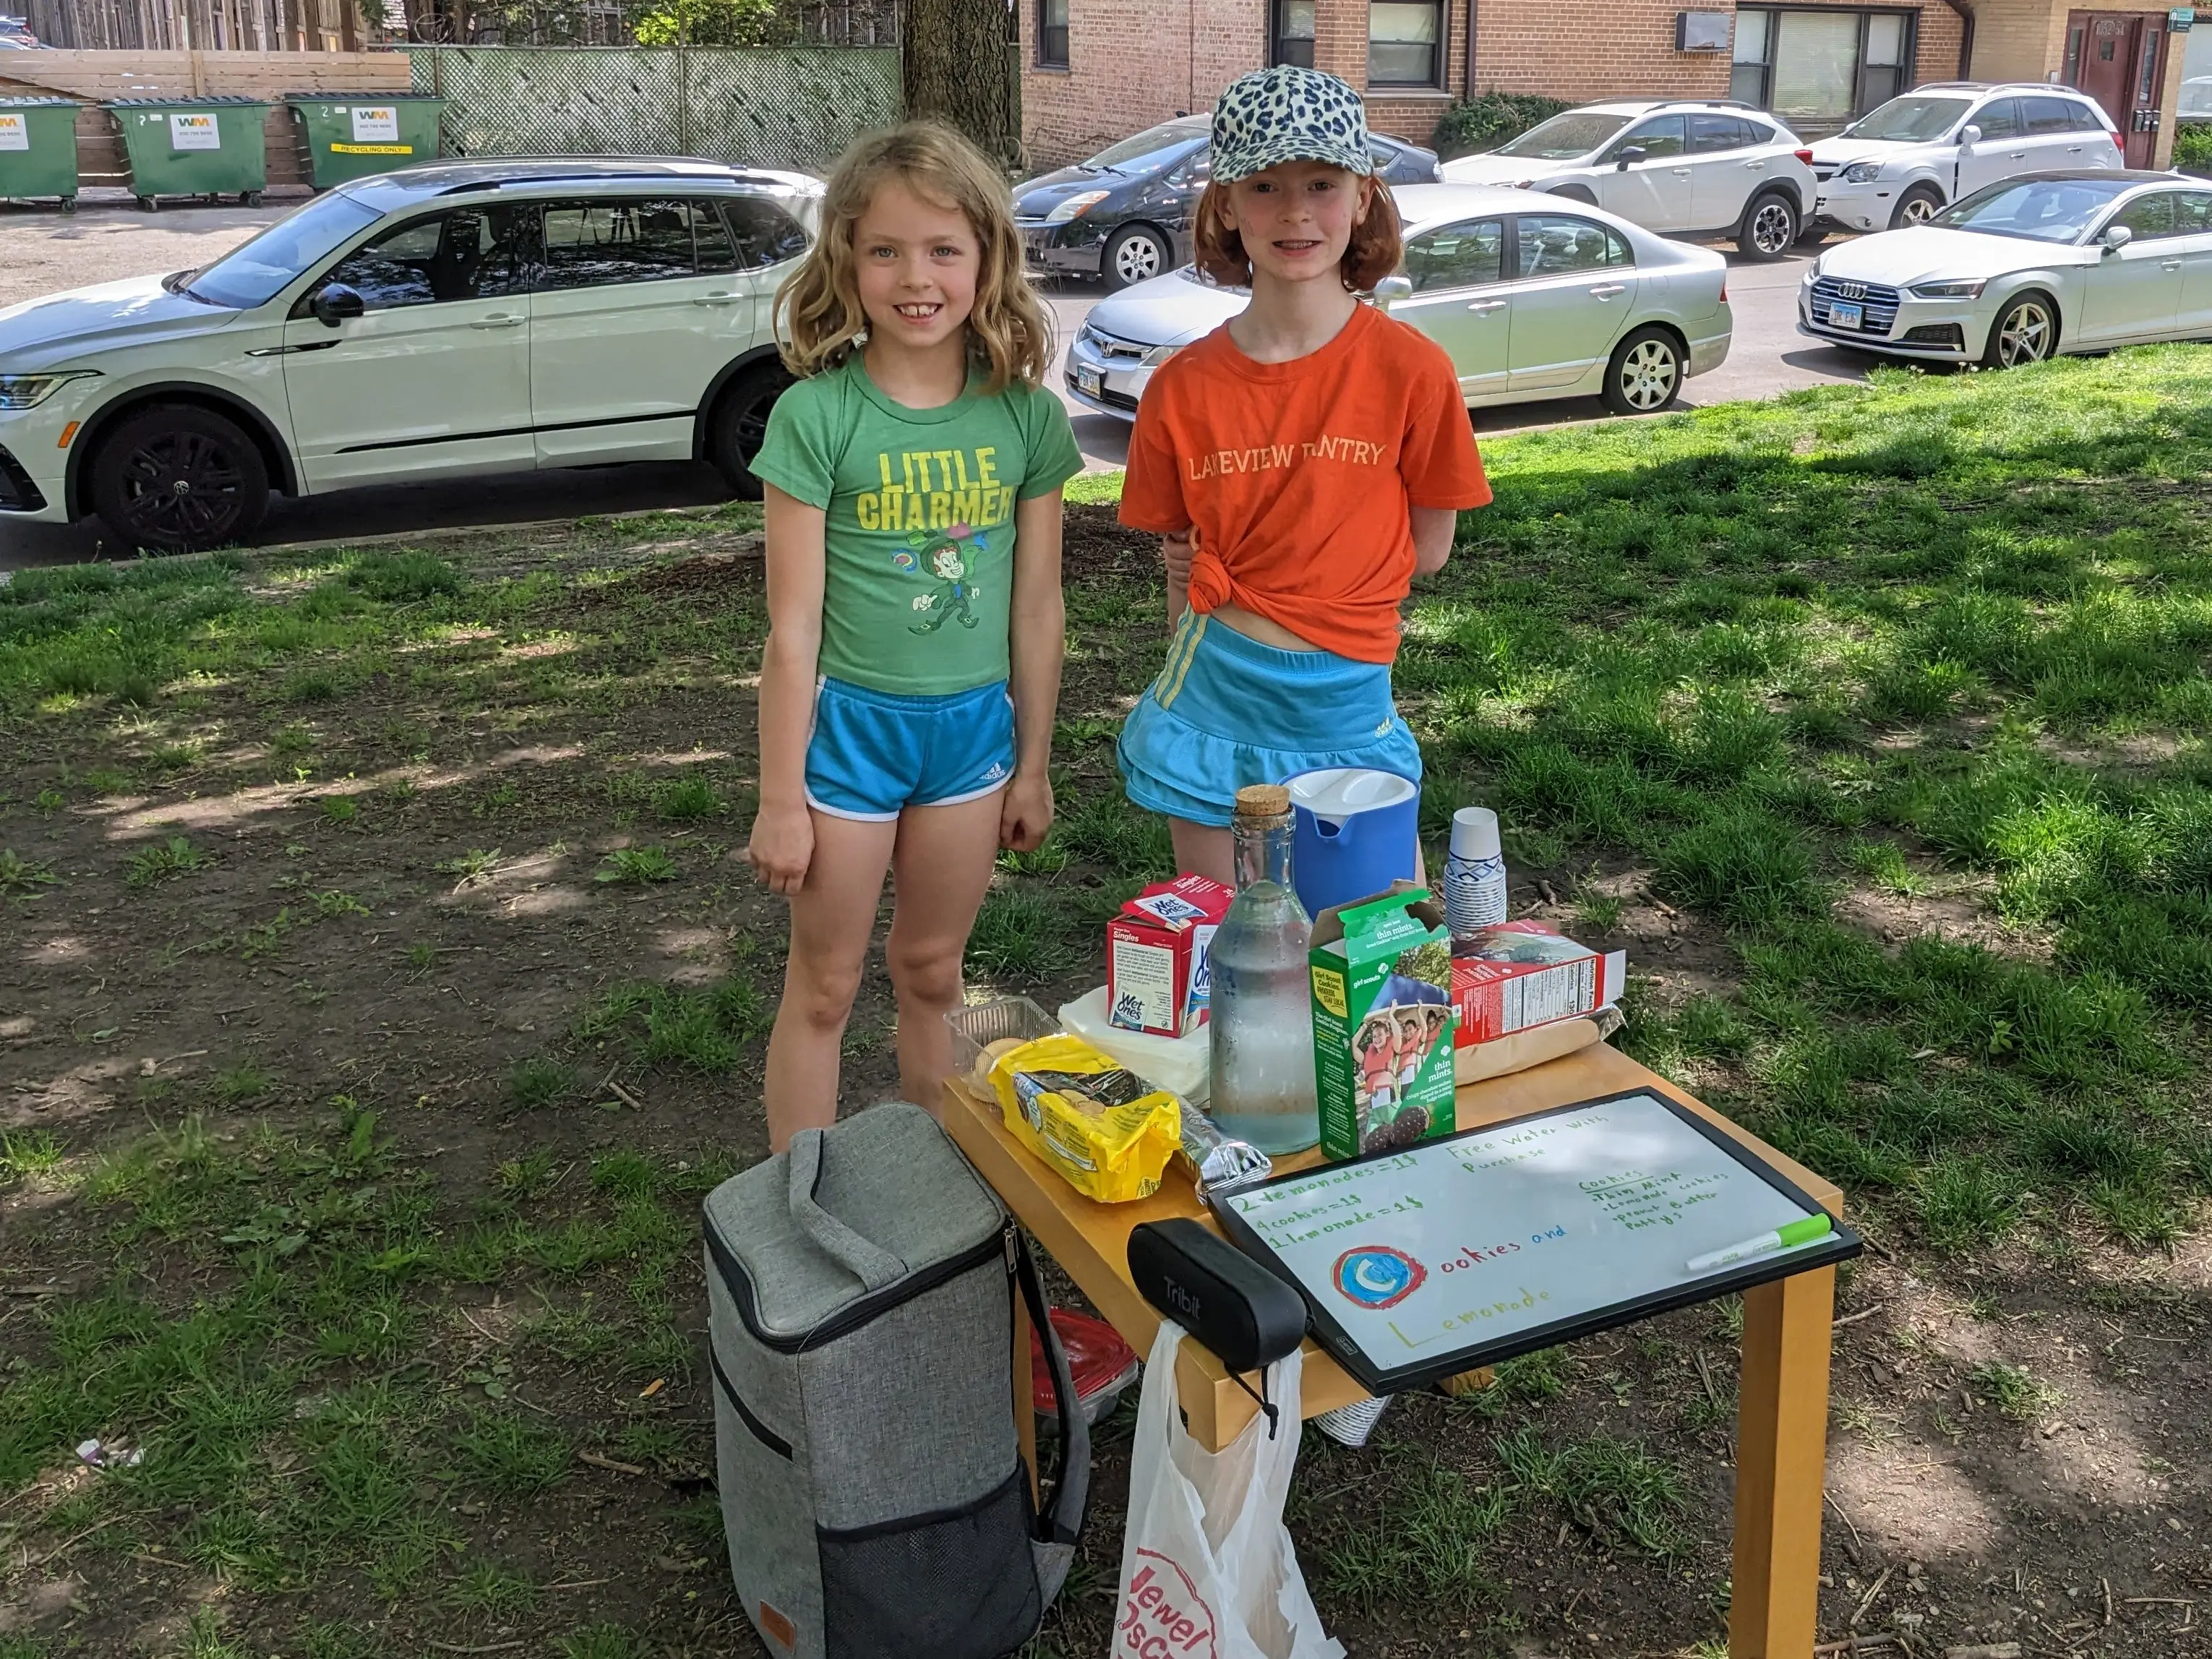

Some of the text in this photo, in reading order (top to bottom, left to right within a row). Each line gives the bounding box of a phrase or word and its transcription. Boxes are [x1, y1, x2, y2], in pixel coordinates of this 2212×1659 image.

[321, 106, 329, 117] 2
[359, 111, 389, 120] WM
[178, 118, 210, 127] WM
[880, 447, 1000, 493] LITTLE
[1189, 445, 1295, 480] LAKEVIEW
[858, 486, 1011, 531] CHARMER
[1149, 899, 1179, 910] Wet
[1159, 904, 1188, 915] Ones
[1113, 931, 1139, 942] Singles
[1376, 930, 1392, 939] thin
[1353, 974, 1381, 989] girl scouts
[1122, 992, 1145, 1011] Wet
[1118, 1002, 1141, 1020] Ones
[1434, 1060, 1451, 1071] thin
[1428, 1069, 1452, 1082] mints
[1446, 1142, 1495, 1159] Free
[1502, 1129, 1556, 1145] Water
[1231, 1197, 1261, 1212] 2
[1532, 1225, 1567, 1243] and
[1163, 1275, 1201, 1320] Tribit
[1388, 1287, 1552, 1349] Lemonade
